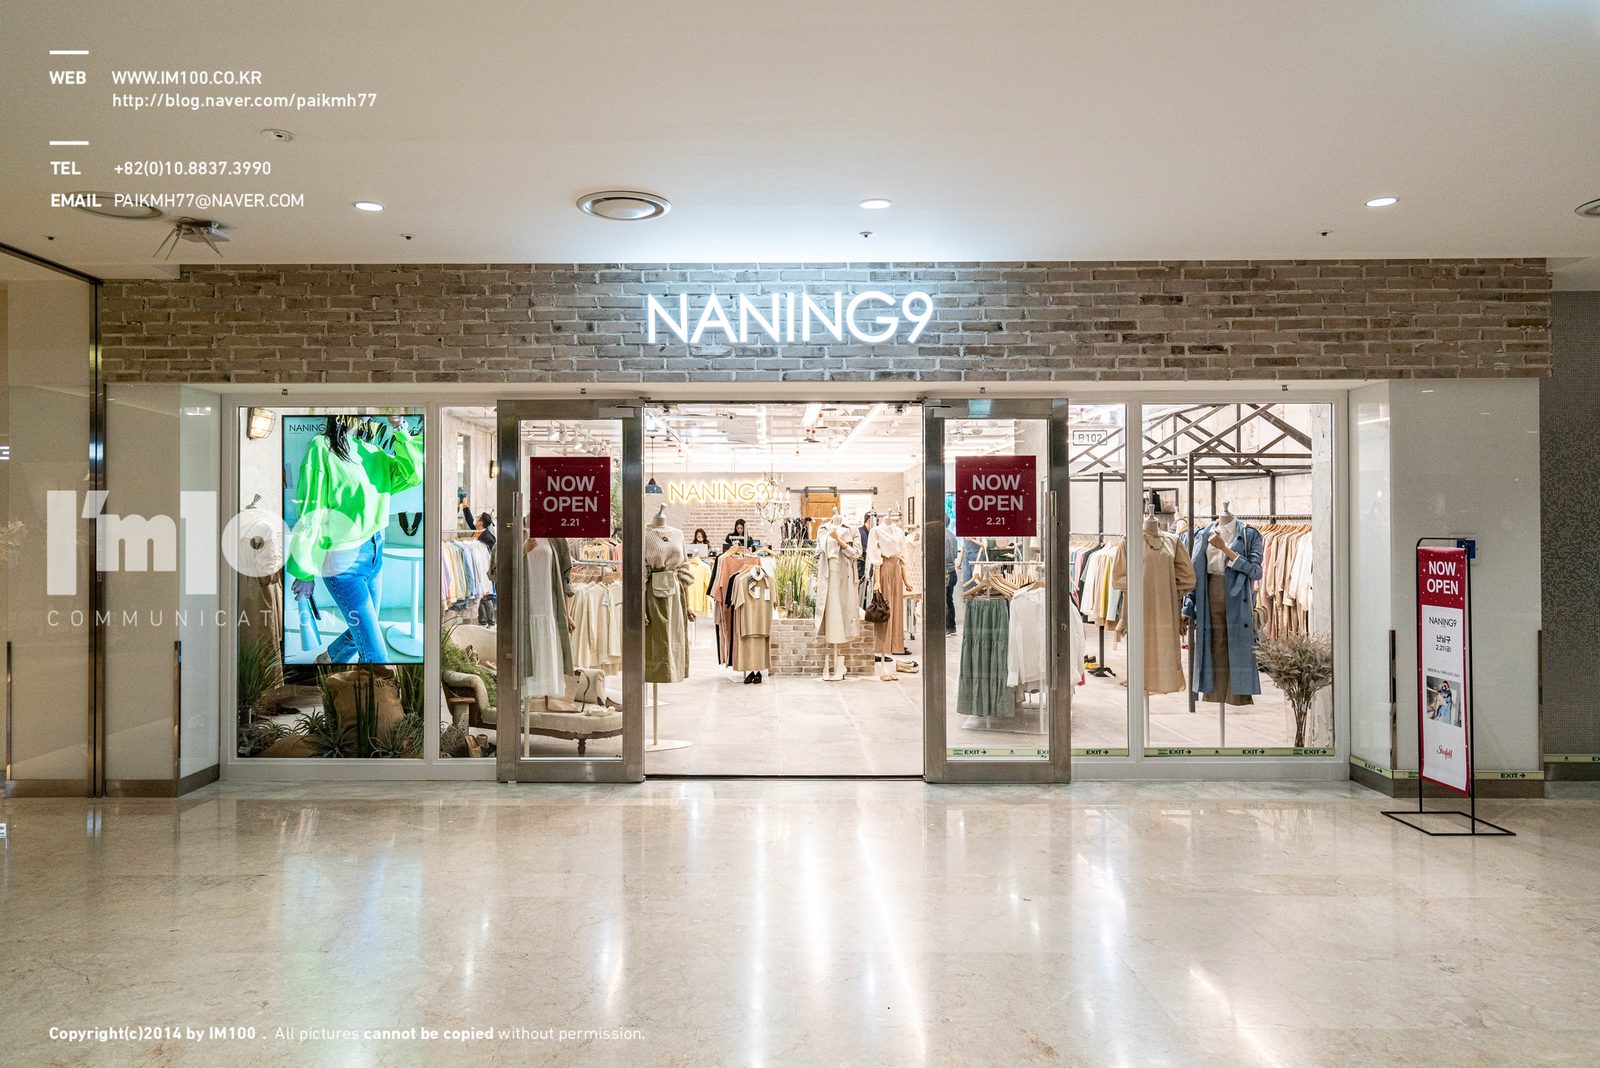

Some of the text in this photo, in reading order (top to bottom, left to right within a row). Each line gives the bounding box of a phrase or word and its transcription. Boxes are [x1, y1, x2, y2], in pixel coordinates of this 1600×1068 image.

[647, 290, 935, 344] NANING9
[547, 475, 595, 492] NOW
[971, 474, 1021, 491] NOW
[543, 496, 598, 513] OPEN
[968, 495, 1024, 512] OPEN
[560, 518, 580, 527] 2.21
[986, 517, 1005, 526] 2.21
[1428, 561, 1456, 577] NOW
[1426, 579, 1459, 595] OPEN
[1429, 616, 1457, 628] NANING9
